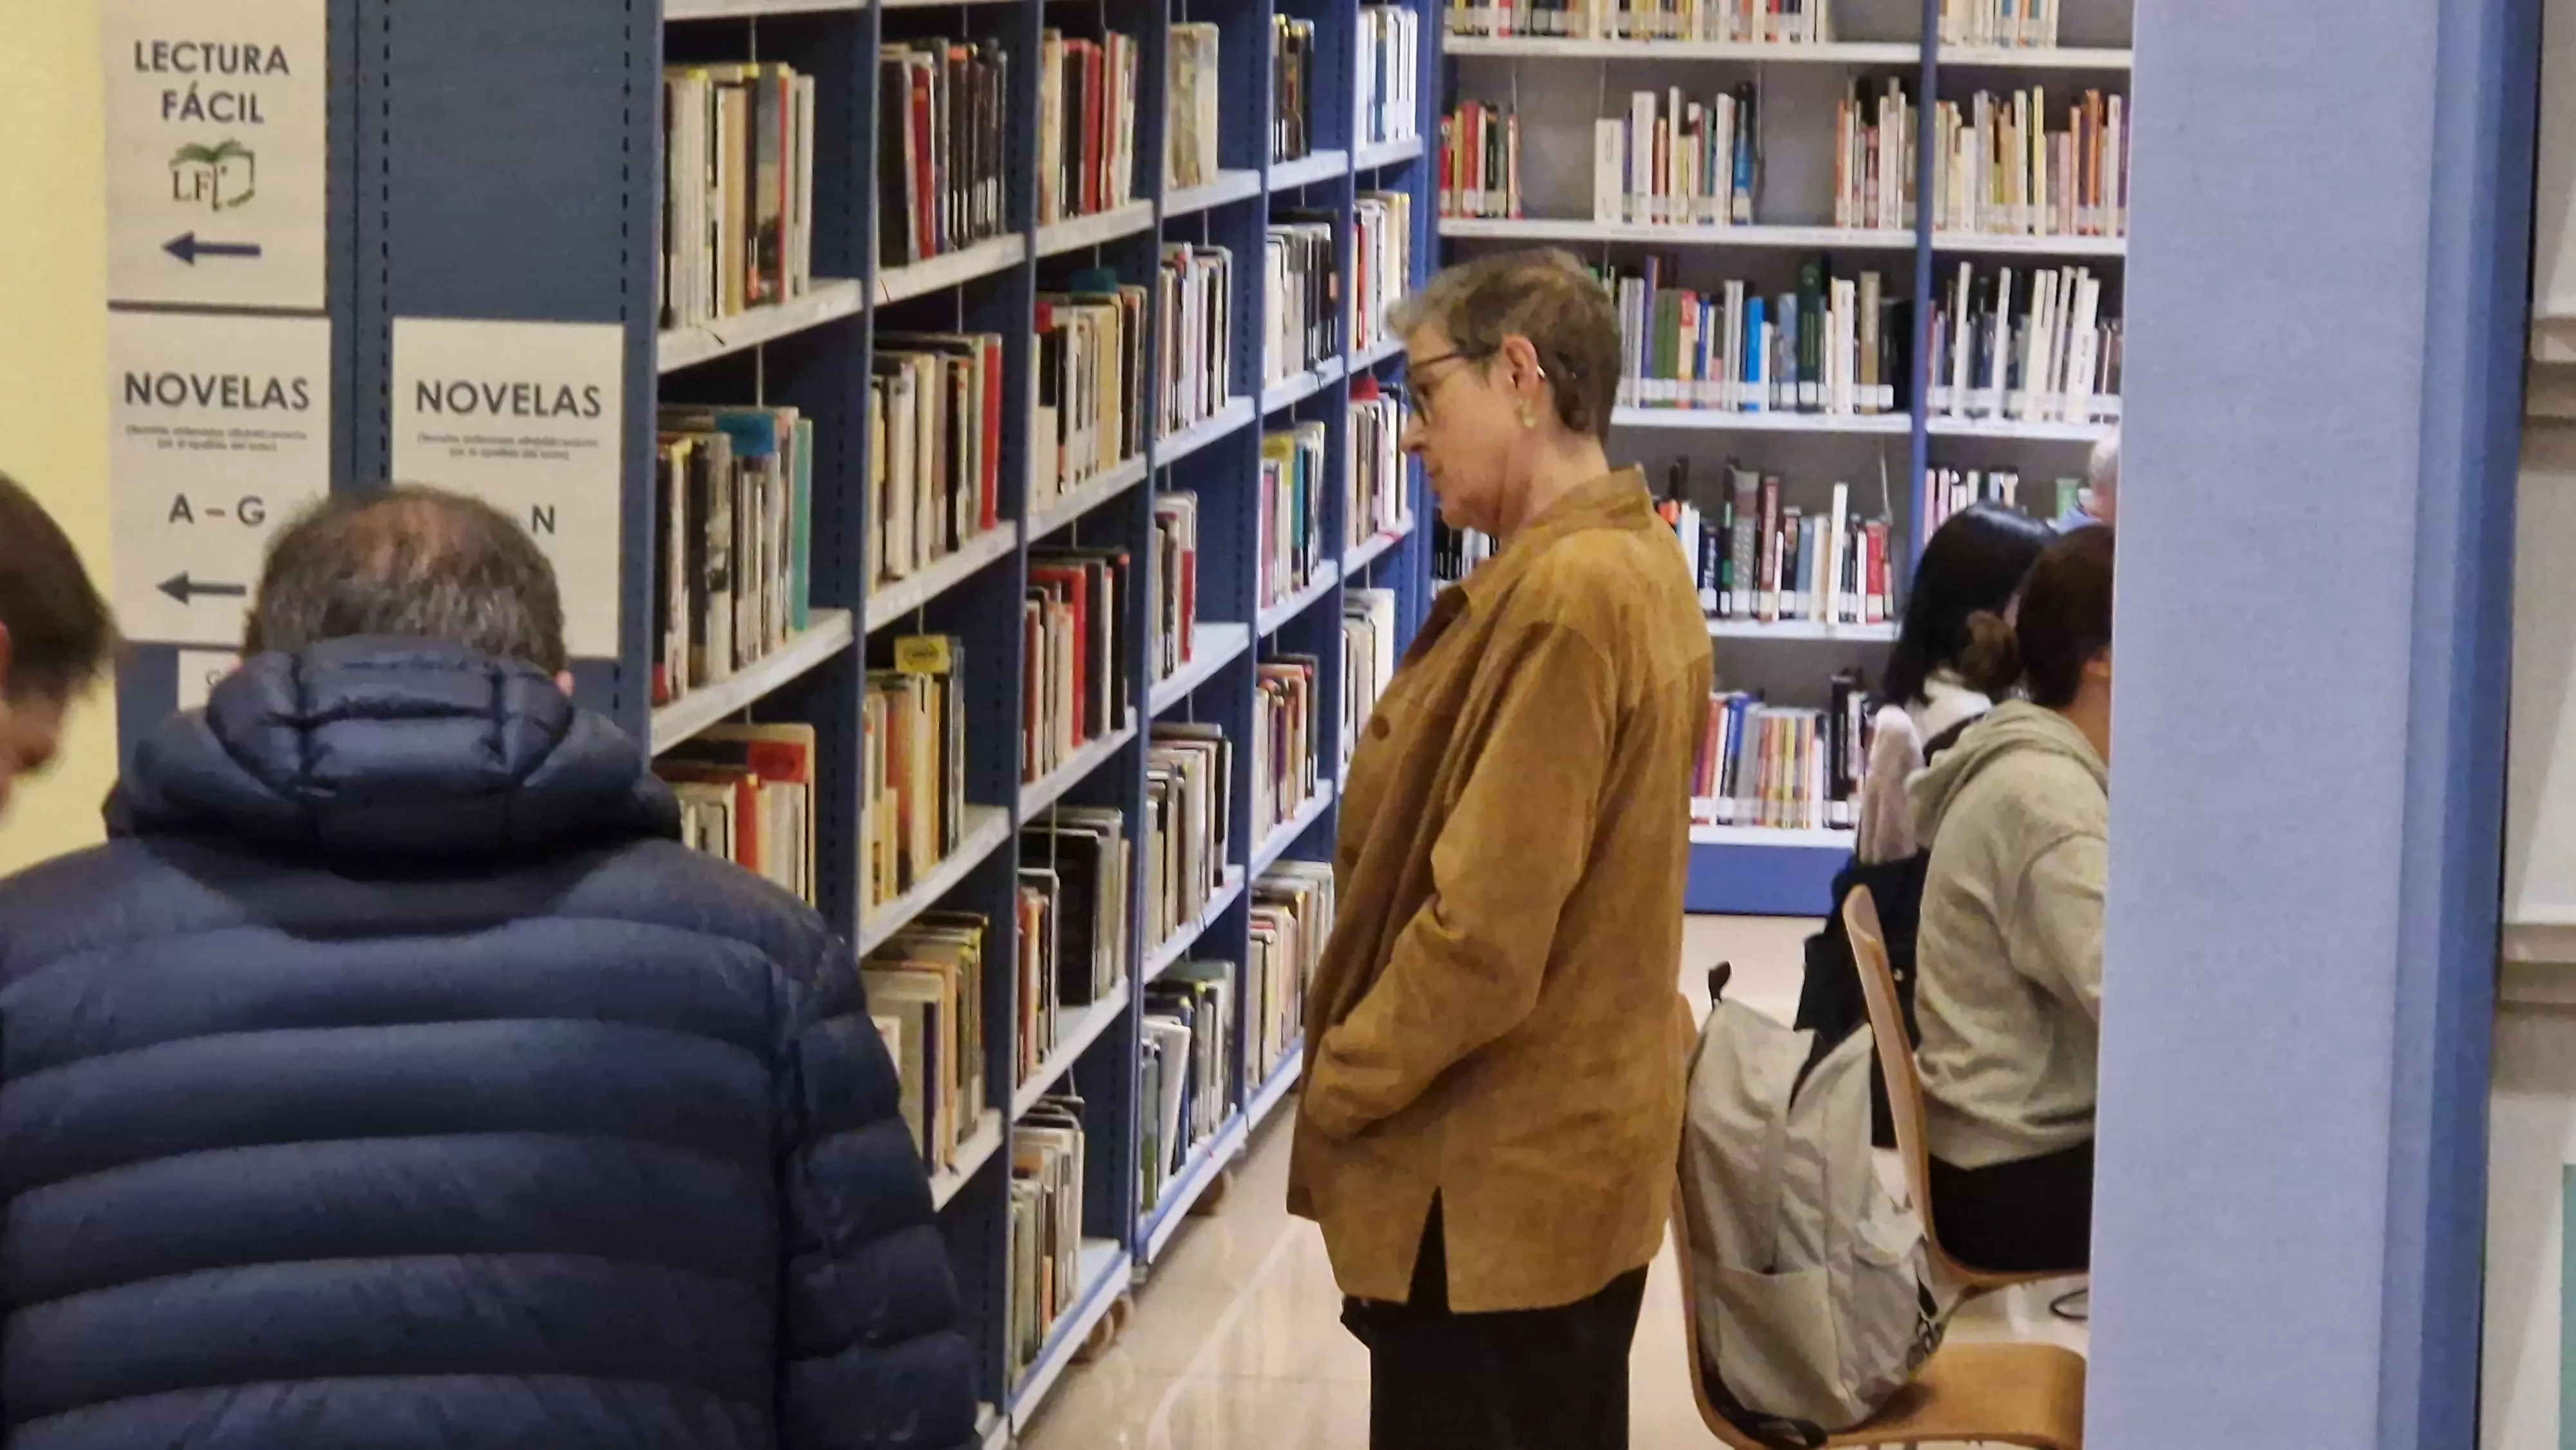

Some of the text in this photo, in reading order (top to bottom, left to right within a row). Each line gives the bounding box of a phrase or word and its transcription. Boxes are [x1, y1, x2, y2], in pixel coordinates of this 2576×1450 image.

[134, 40, 290, 77] LECTURA
[161, 81, 264, 124] FÁCIL
[124, 371, 310, 411] NOVELAS
[416, 380, 601, 419] NOVELAS
[168, 493, 194, 524] A
[236, 495, 265, 527] G
[531, 504, 556, 535] N
